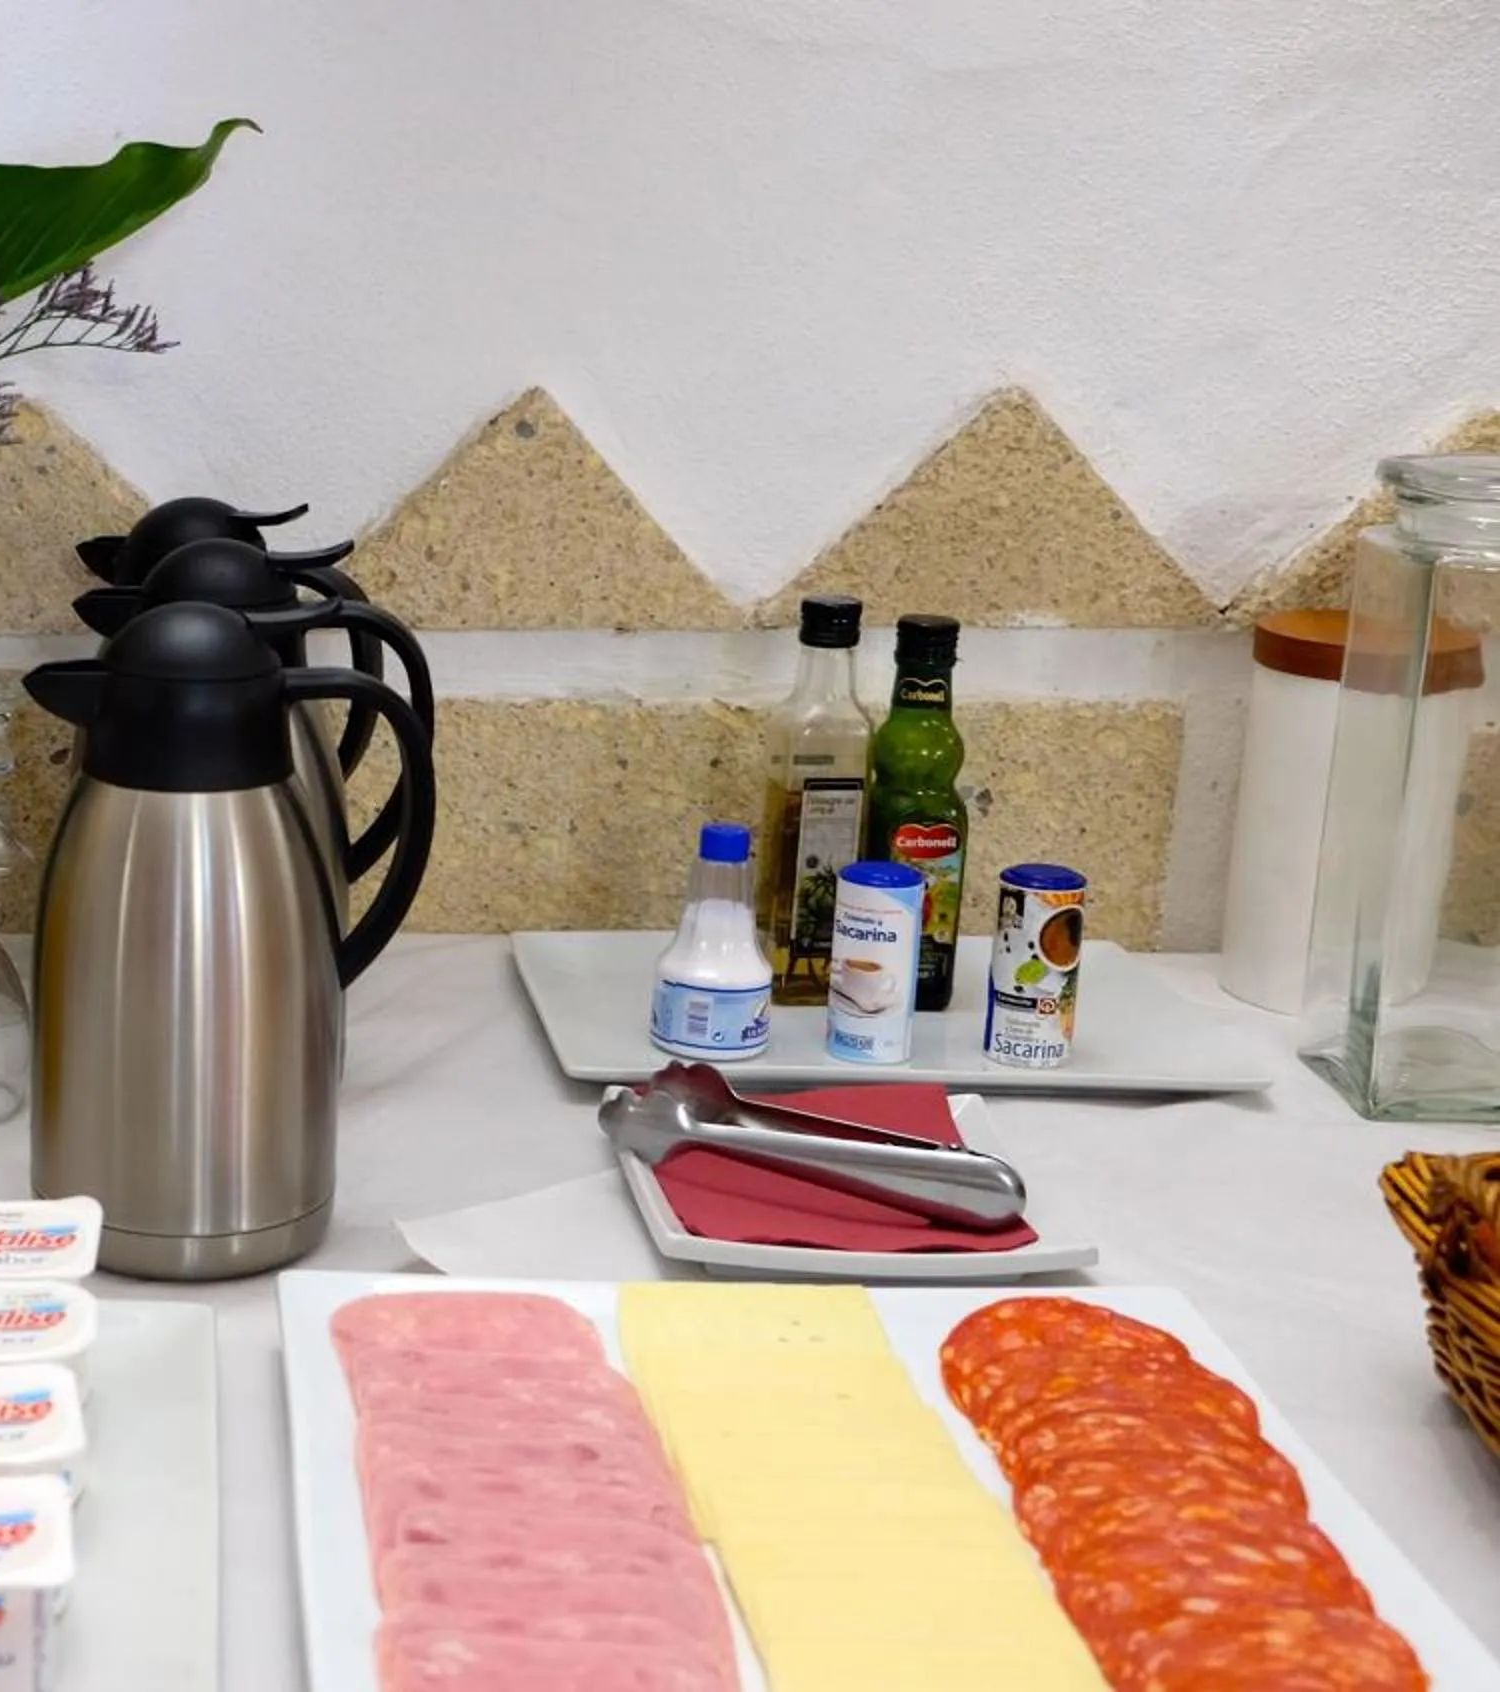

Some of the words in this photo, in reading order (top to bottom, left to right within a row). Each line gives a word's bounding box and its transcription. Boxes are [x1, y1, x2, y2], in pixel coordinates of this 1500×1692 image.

[895, 834, 958, 849] Carbonell
[835, 919, 898, 943] Sacarina
[994, 1033, 1065, 1060] Sacarina
